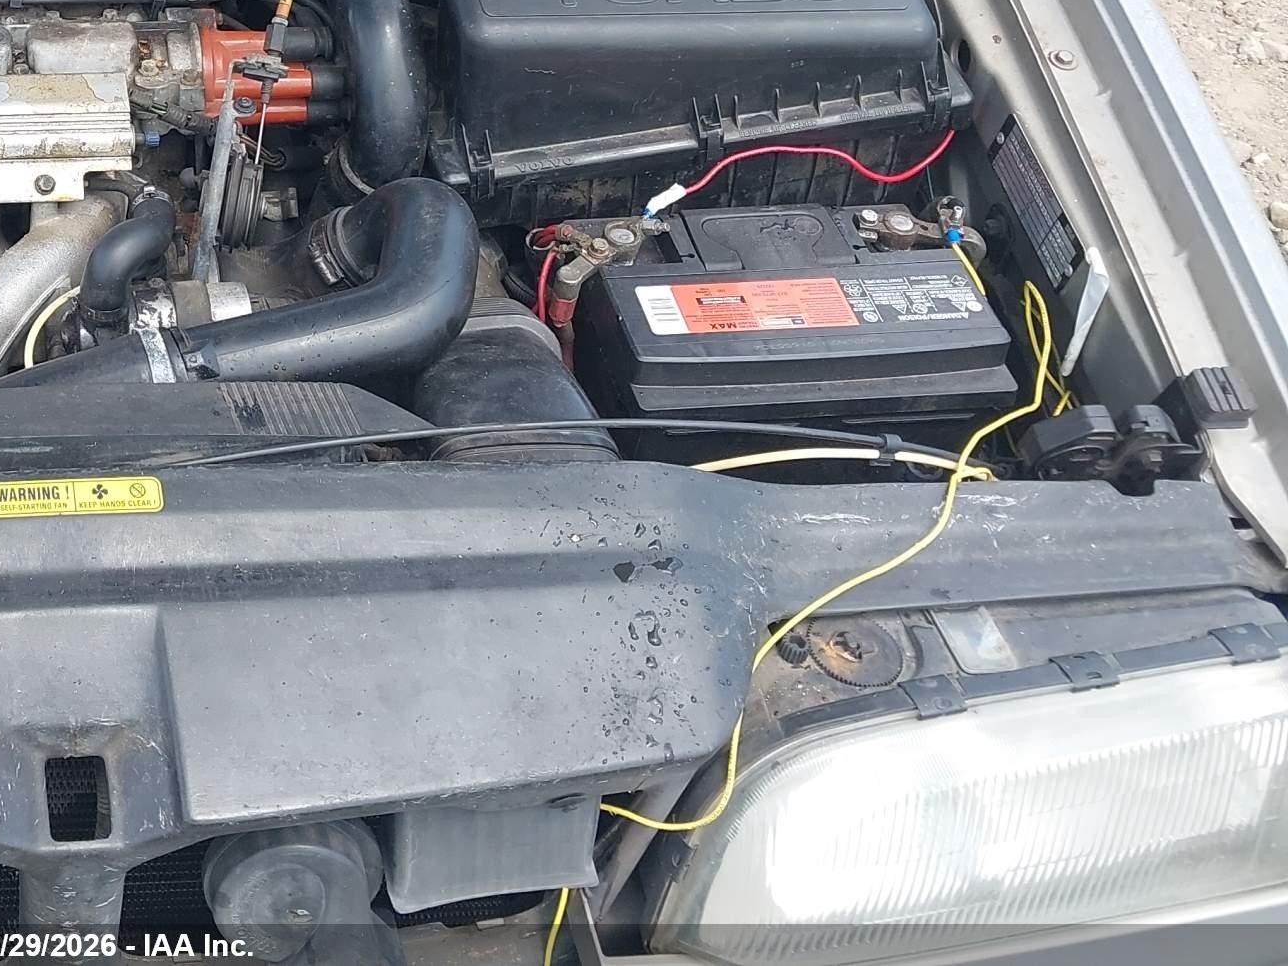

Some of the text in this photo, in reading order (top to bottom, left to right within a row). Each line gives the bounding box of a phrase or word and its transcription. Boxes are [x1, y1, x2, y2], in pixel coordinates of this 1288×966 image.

[514, 155, 572, 173] VOLVO
[709, 322, 737, 330] MAX
[0, 502, 52, 511] SELF-STARTING
[78, 500, 98, 509] KEEP
[99, 500, 126, 508] HANDS
[127, 499, 152, 507] CLEAR
